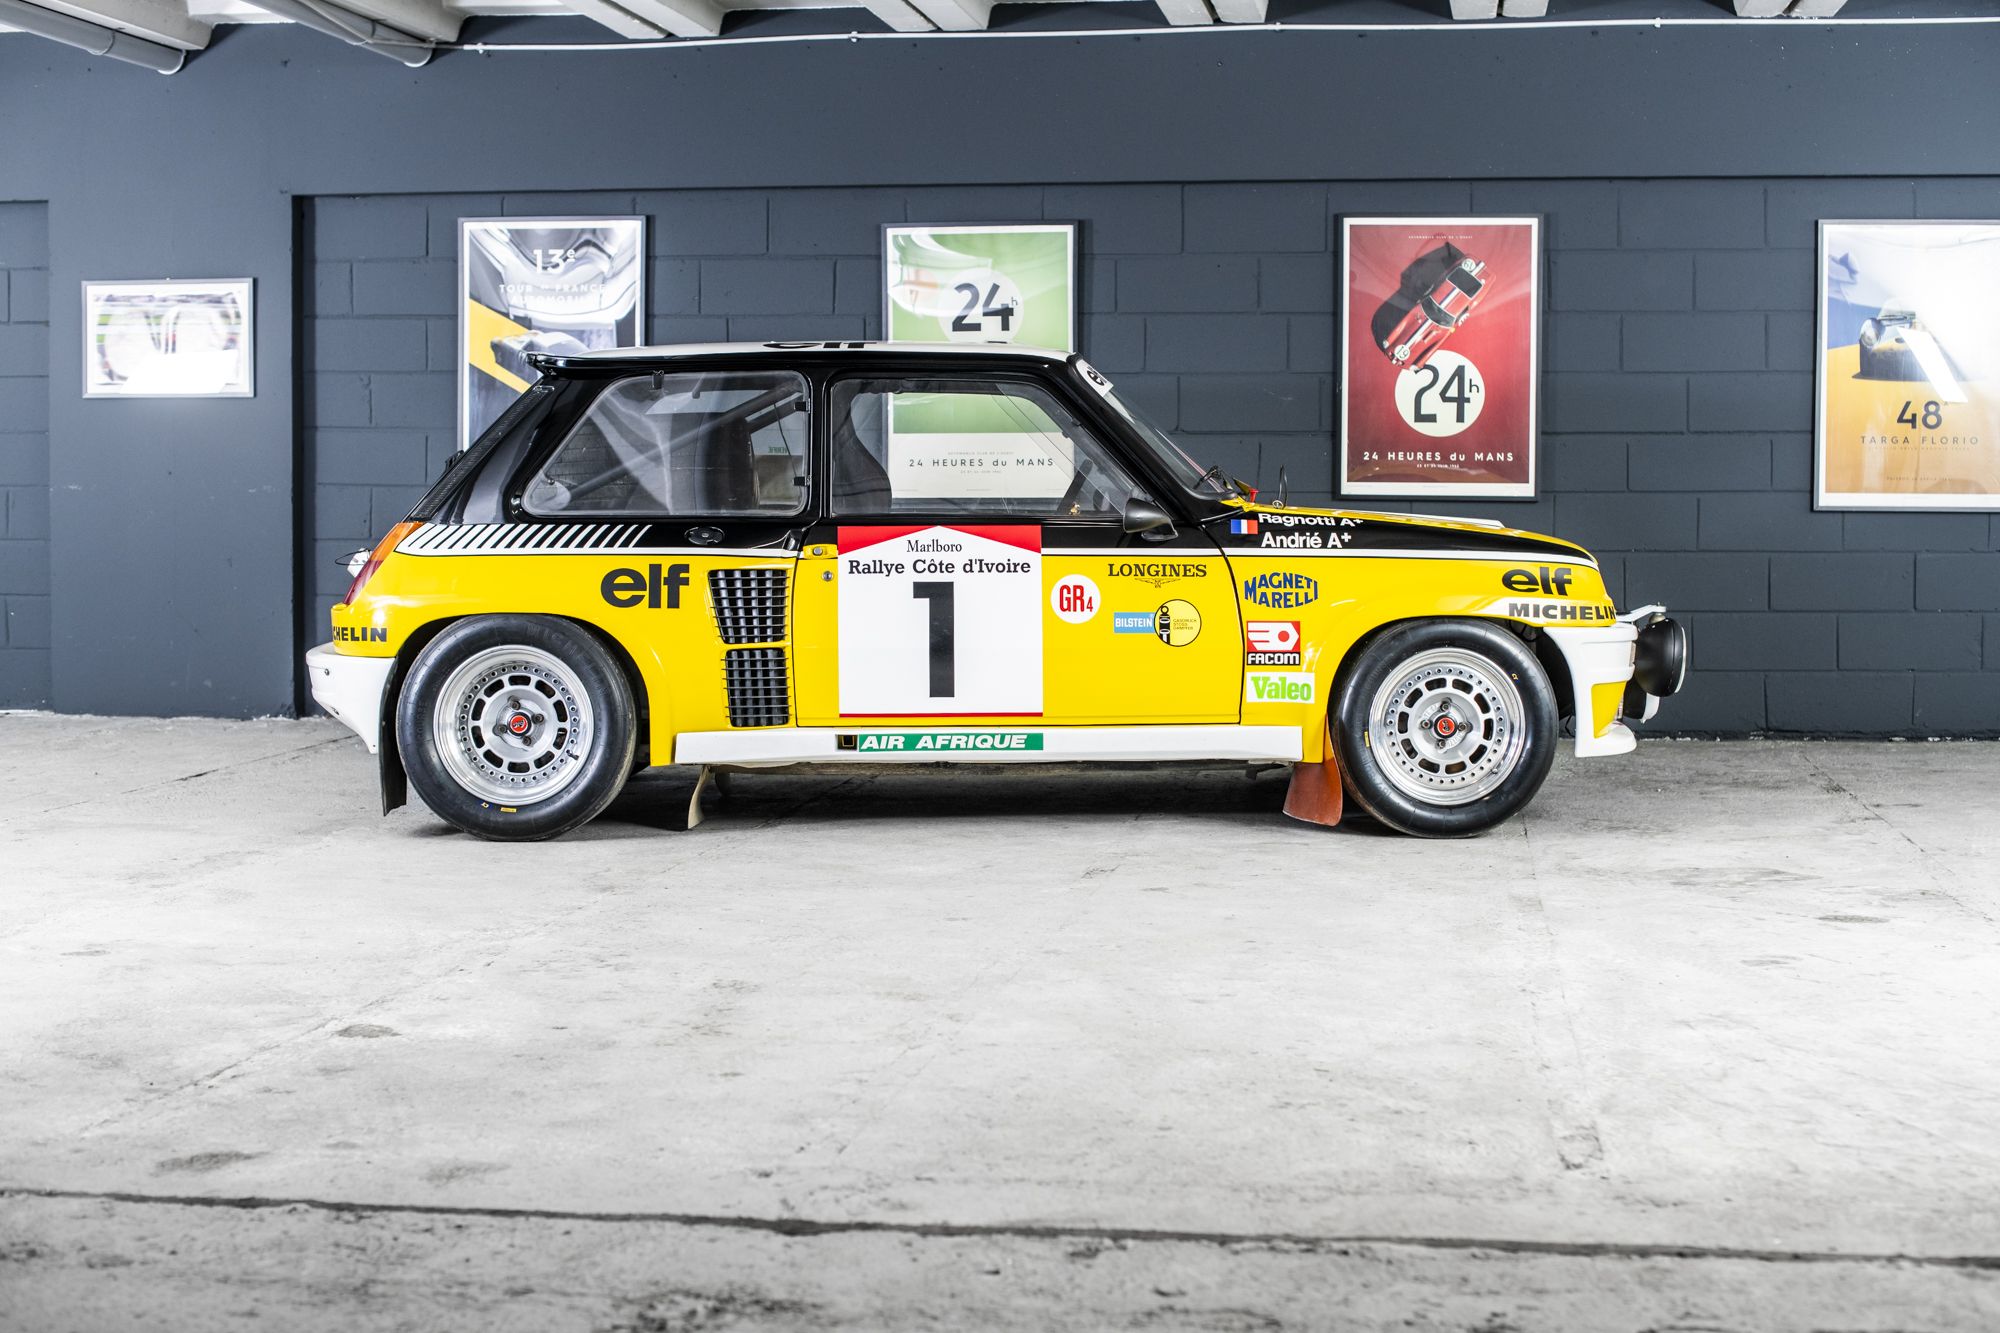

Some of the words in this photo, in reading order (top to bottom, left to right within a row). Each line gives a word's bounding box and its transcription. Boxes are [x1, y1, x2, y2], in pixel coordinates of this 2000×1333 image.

[499, 284, 533, 292] TOUR
[555, 284, 605, 292] FRANCE
[952, 282, 1018, 332] 24h
[1414, 364, 1480, 423] 24h
[1861, 436, 1910, 445] TARGA
[1921, 436, 1979, 445] FLORIO
[909, 459, 923, 467] 24
[932, 459, 984, 467] HEURES
[992, 458, 1007, 467] du
[1016, 458, 1054, 467] MANS
[1363, 452, 1379, 461] 24
[1388, 452, 1441, 461] HEURES
[1450, 452, 1466, 461] du
[1475, 452, 1514, 462] MANS
[1258, 513, 1336, 527] Ragnotti
[1340, 518, 1363, 527] A+
[907, 539, 962, 553] Marlboro
[1261, 532, 1322, 548] Andrié
[1327, 532, 1352, 548] A+
[848, 560, 905, 577] Rallye
[912, 558, 955, 574] Côte
[962, 558, 1031, 574] d'Ivoire
[1108, 563, 1207, 578] LONGINES
[600, 564, 690, 608] elf
[1244, 572, 1318, 596] MAGNETI
[1502, 566, 1572, 597] elf
[1244, 584, 1318, 608] MARELLI
[1508, 602, 1617, 620] MICHELIN
[1115, 617, 1153, 628] BILSTEIN
[913, 581, 955, 697] 1
[1247, 653, 1300, 665] FACOM
[1251, 676, 1312, 701] Valeo
[860, 735, 905, 750] AIR
[915, 734, 1028, 749] AFRIQUE
